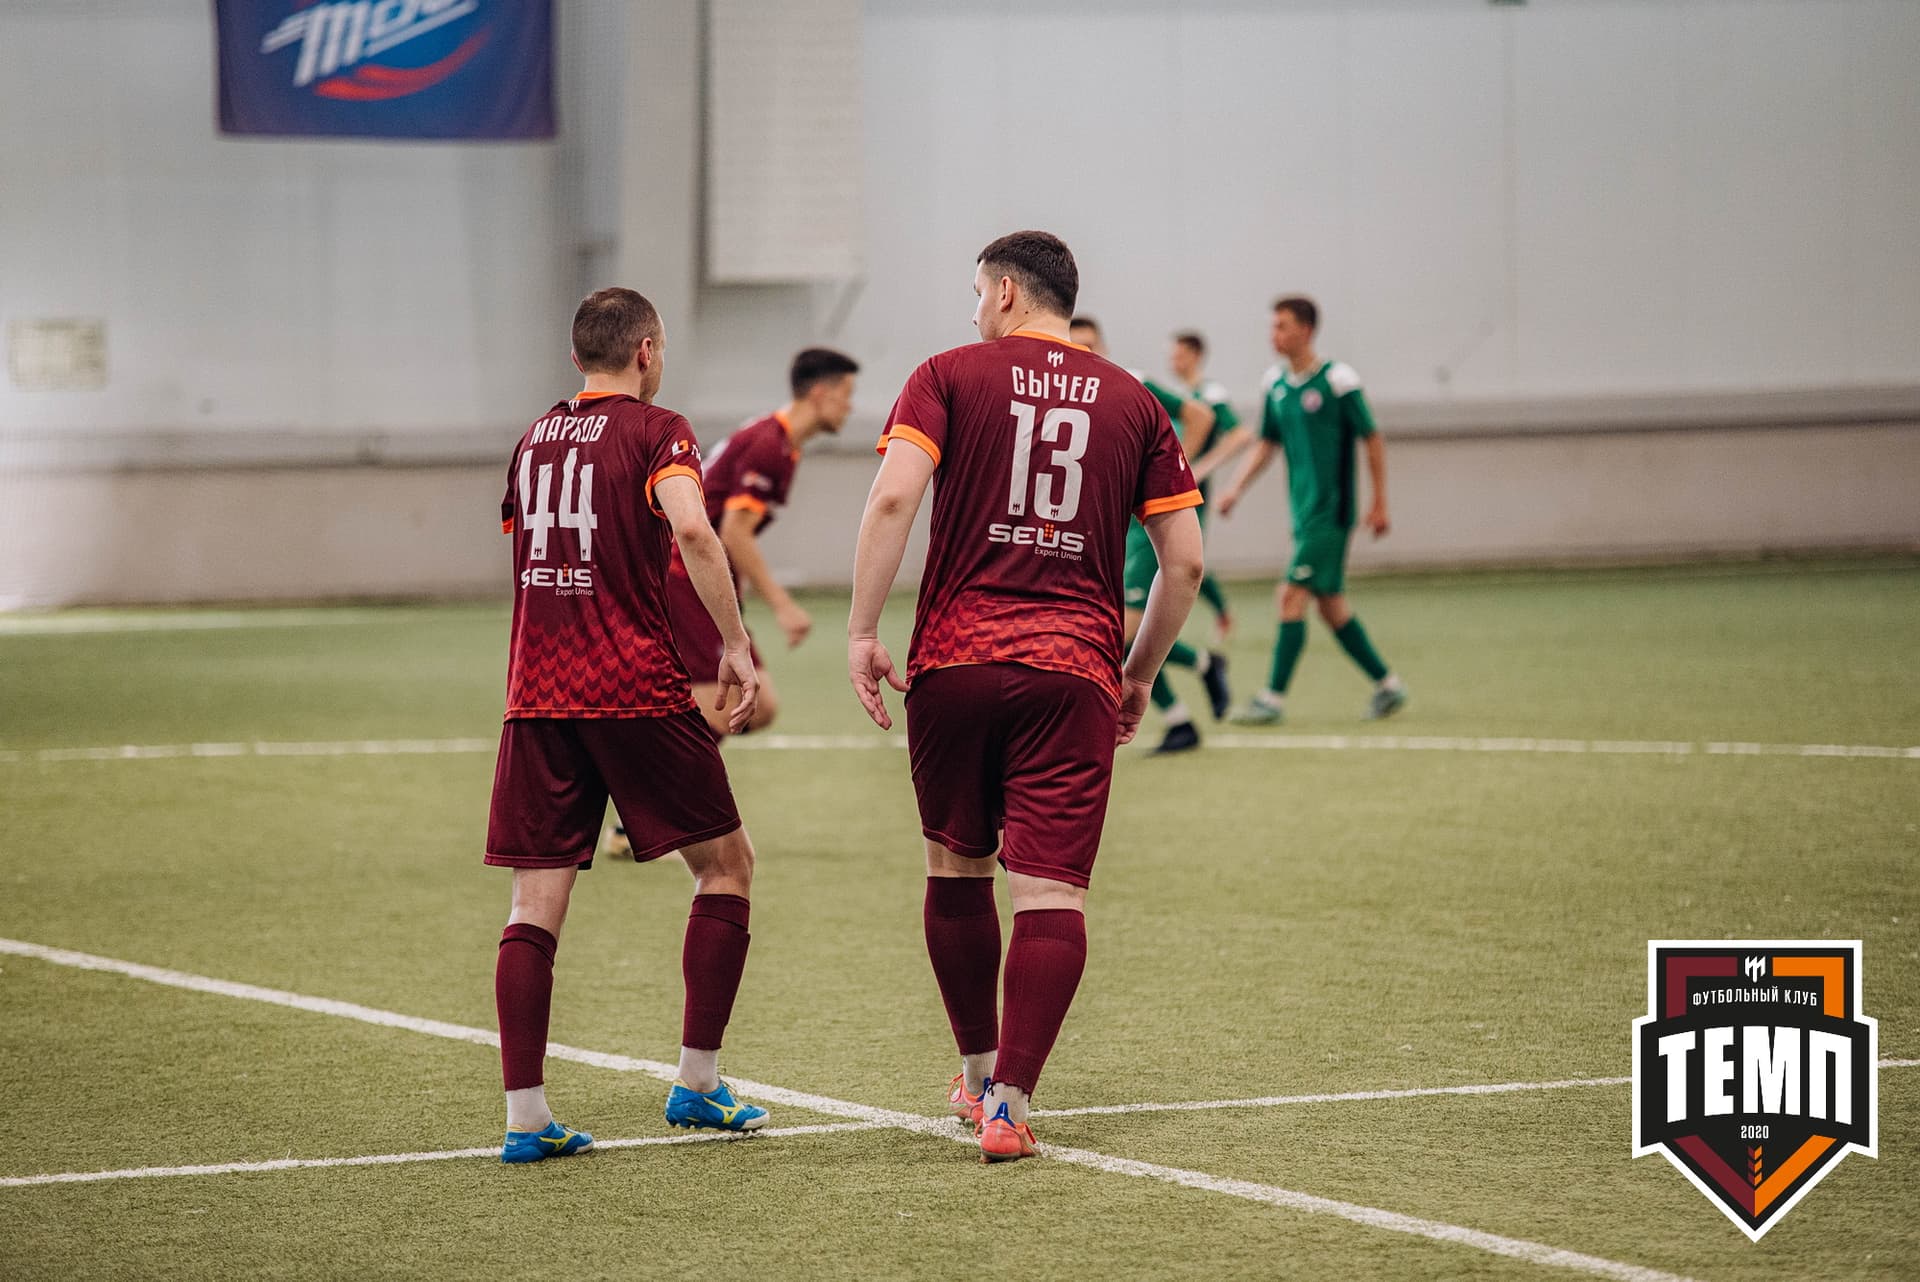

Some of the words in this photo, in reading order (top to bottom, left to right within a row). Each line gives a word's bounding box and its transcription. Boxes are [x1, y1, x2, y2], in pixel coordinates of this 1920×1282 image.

[1011, 365, 1100, 404] СЫЧЕВ
[1008, 400, 1091, 522] 13
[518, 447, 598, 562] 44
[1034, 546, 1059, 558] Export
[1060, 551, 1082, 561] Union
